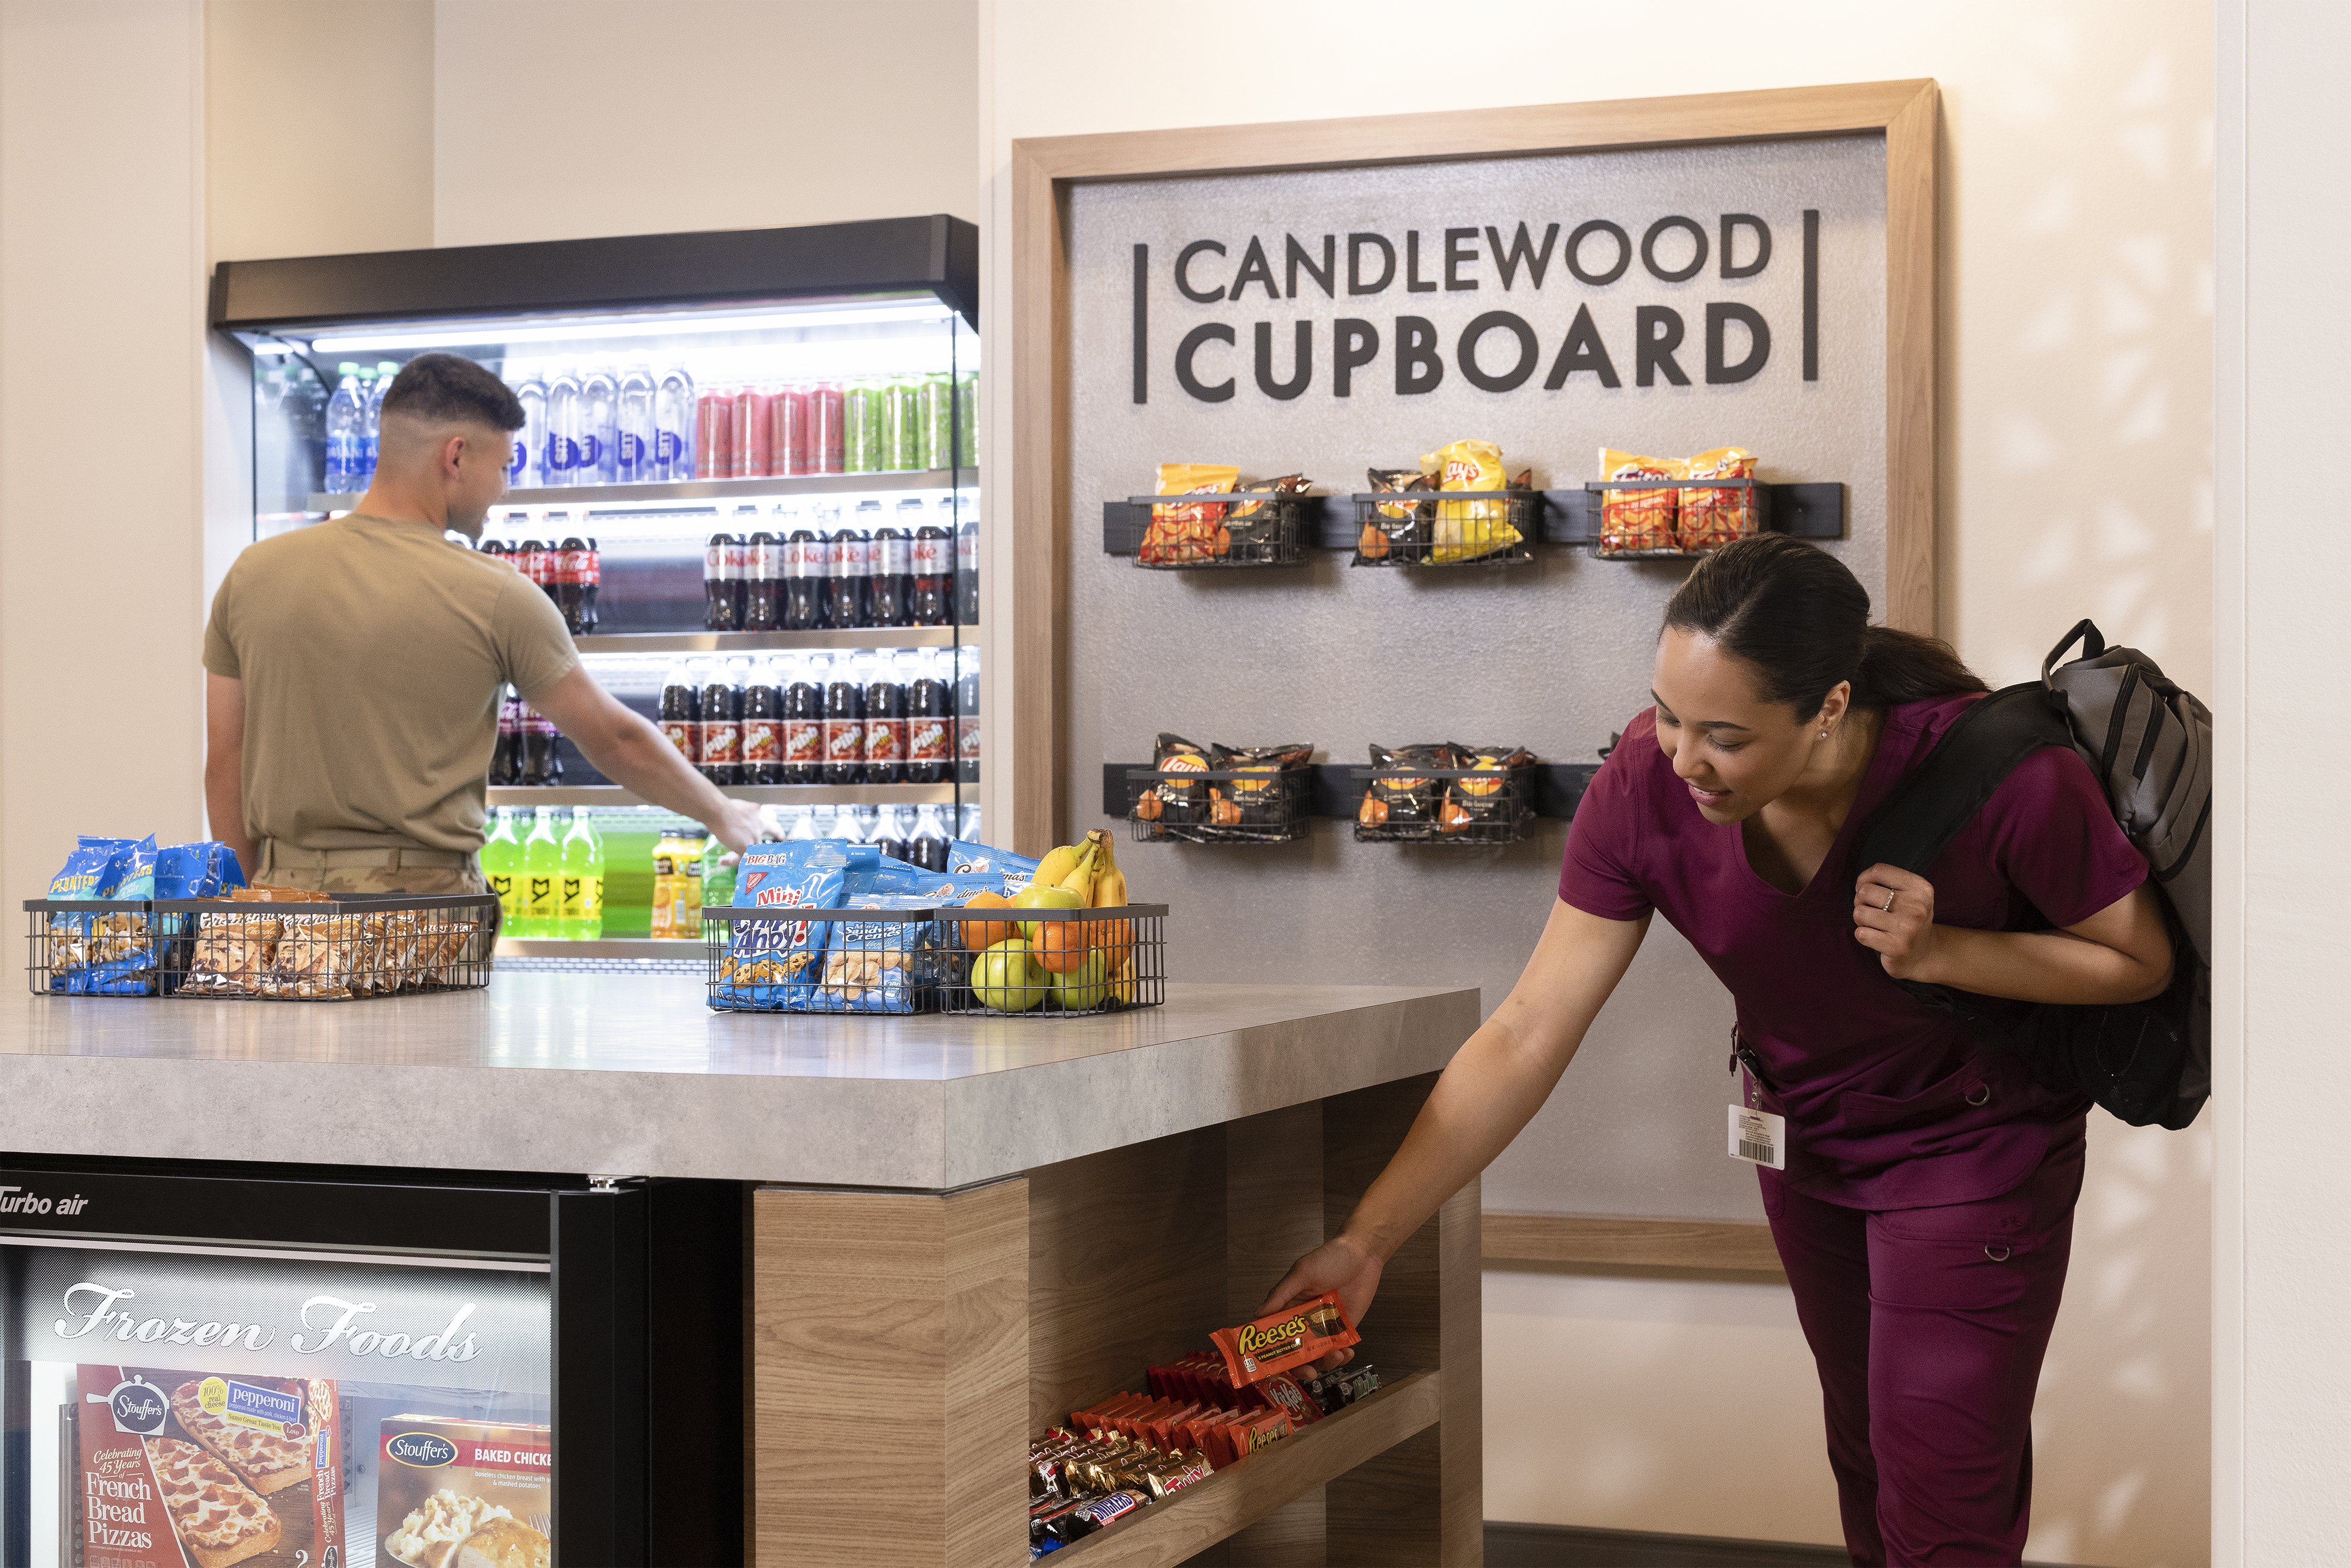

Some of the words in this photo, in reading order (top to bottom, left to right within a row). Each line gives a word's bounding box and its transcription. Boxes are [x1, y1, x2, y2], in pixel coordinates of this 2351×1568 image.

[1174, 212, 1772, 302] CANDLEWOOD
[1175, 301, 1772, 403] CUPBOARD
[747, 855, 766, 865] BIG
[766, 854, 786, 864] BAG
[756, 886, 802, 907] Mini
[846, 929, 901, 942] Cremes
[866, 937, 896, 947] Vanlla
[56, 1194, 88, 1215] air
[54, 1282, 276, 1352] Frozen
[290, 1295, 484, 1362] Foods
[1238, 1315, 1307, 1355] Reese's
[1261, 1351, 1277, 1359] PEANUT
[1277, 1345, 1291, 1354] BUTTER
[203, 1385, 224, 1396] 100%
[209, 1394, 221, 1402] real
[233, 1388, 295, 1413] pepperoni
[117, 1395, 162, 1420] Stouffer's
[205, 1401, 226, 1409] cheese
[228, 1413, 243, 1422] Same
[243, 1417, 257, 1425] Great
[257, 1420, 272, 1429] Taste
[272, 1423, 282, 1431] You
[286, 1426, 300, 1436] Love
[394, 1439, 449, 1461] Stouffer's
[1248, 1427, 1278, 1455] Reese's
[93, 1448, 142, 1464] Celebrating
[474, 1448, 511, 1463] BAKED
[99, 1462, 113, 1474] 45
[113, 1459, 141, 1475] Years
[85, 1471, 152, 1500] French
[316, 1469, 324, 1502] French
[86, 1496, 146, 1524] Bread
[1087, 1492, 1133, 1521] SNICKERS
[320, 1502, 331, 1543] Celebrating
[88, 1520, 152, 1549] Pizzas
